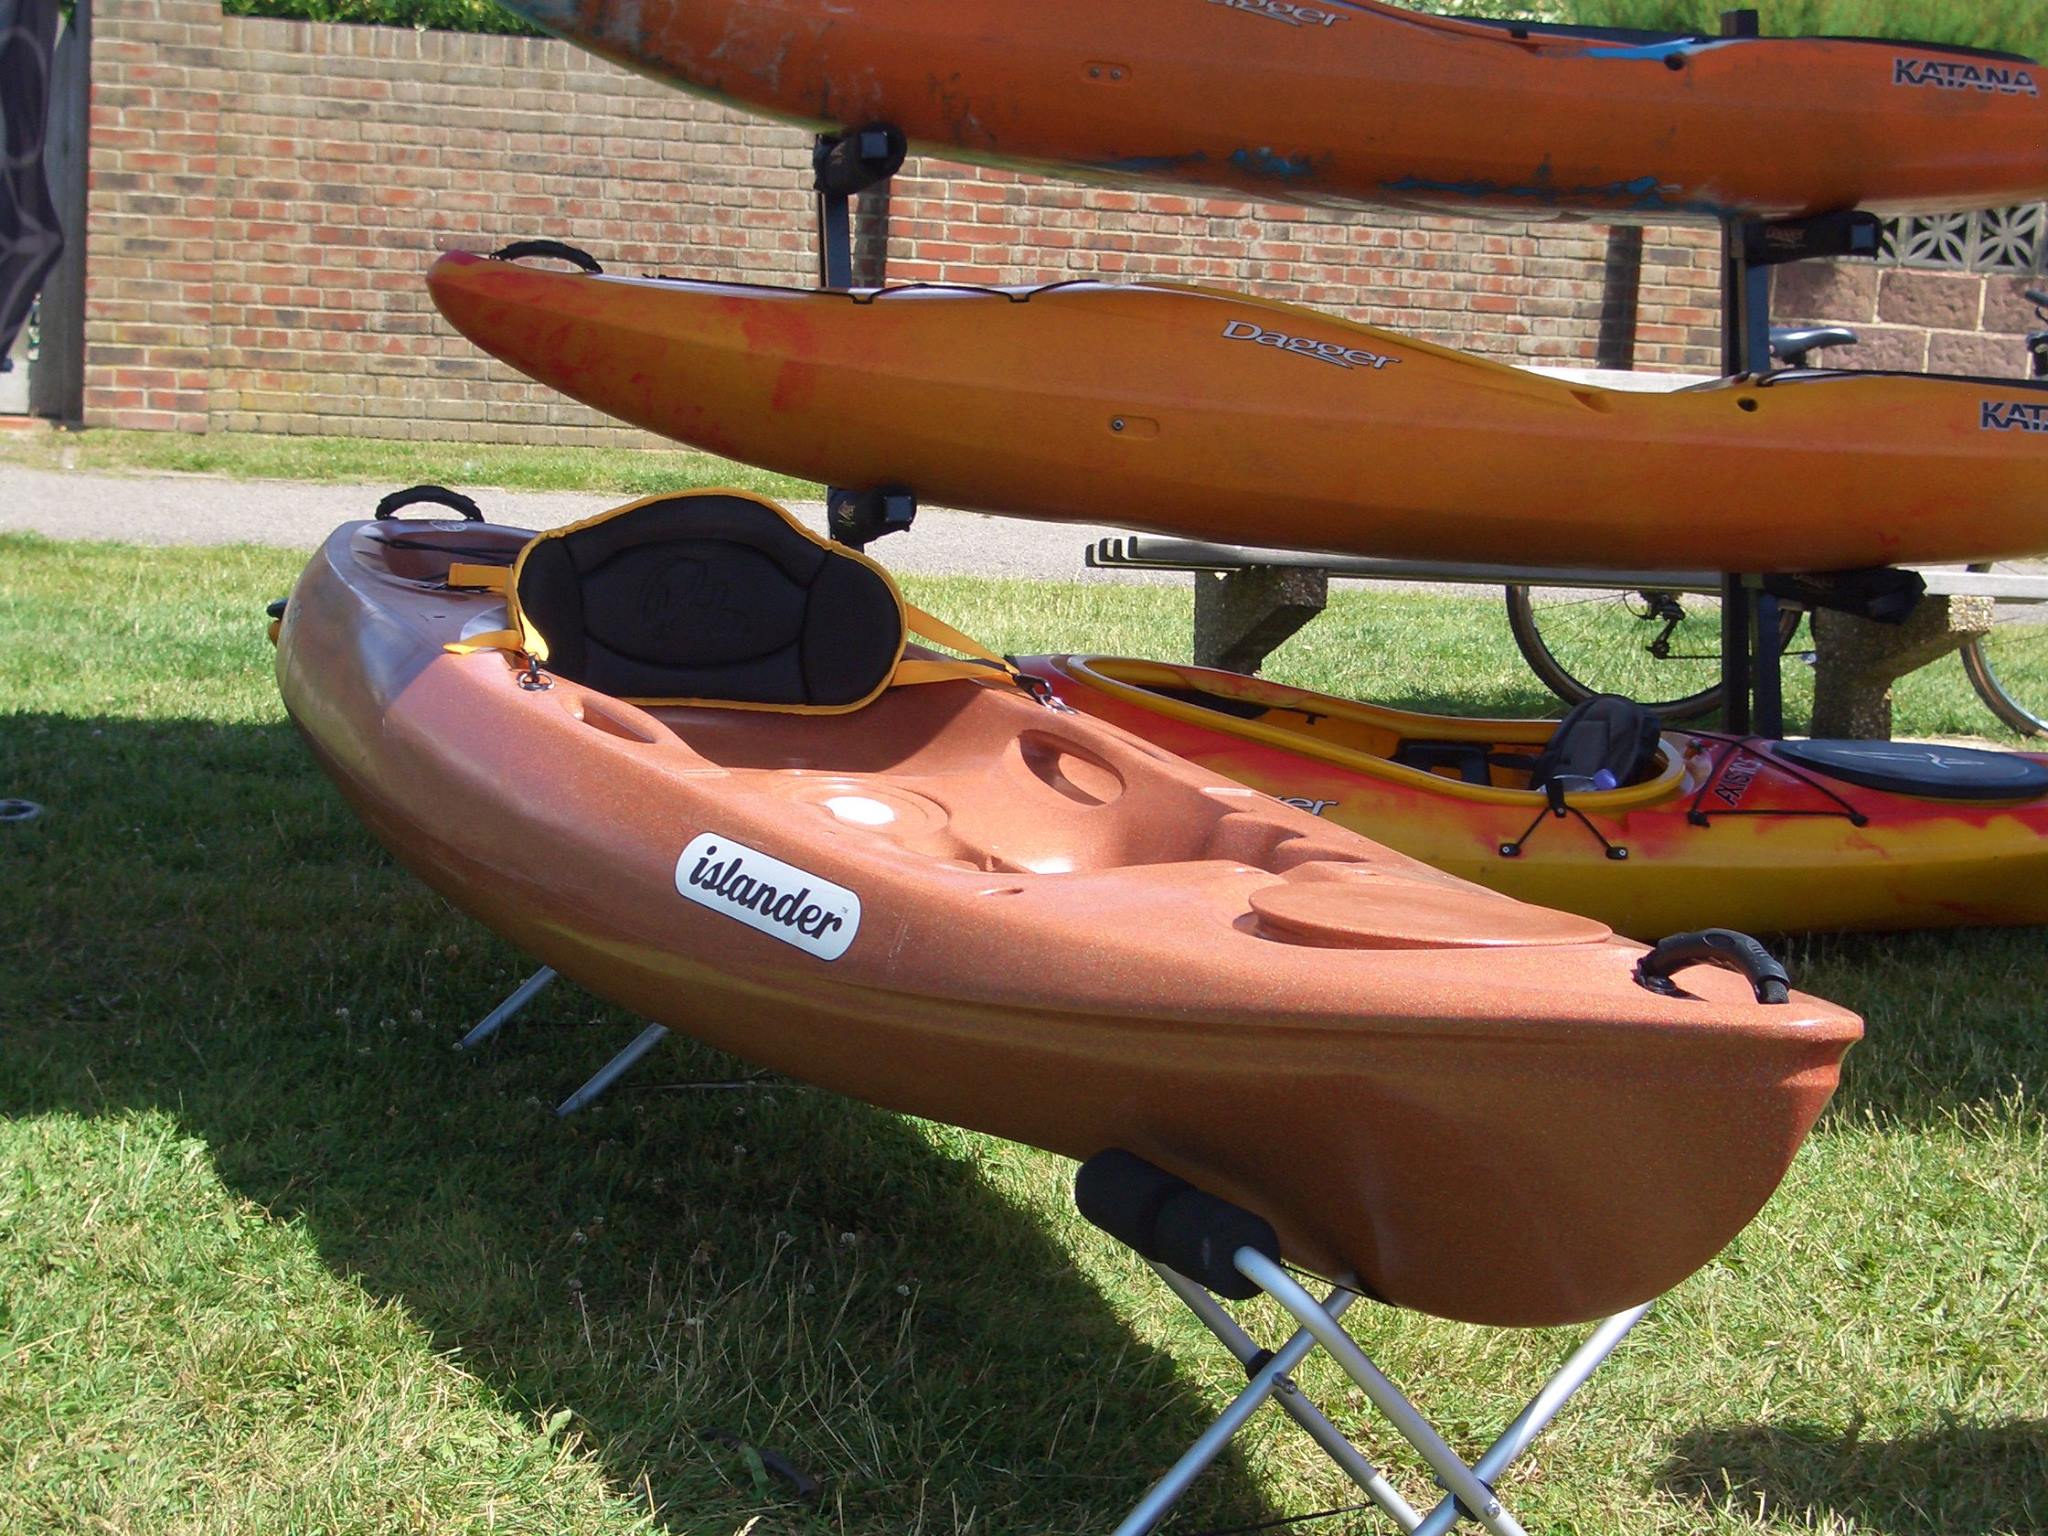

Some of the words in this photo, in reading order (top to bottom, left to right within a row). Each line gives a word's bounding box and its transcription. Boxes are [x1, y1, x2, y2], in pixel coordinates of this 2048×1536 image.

[1893, 56, 2039, 98] KATANA
[1222, 319, 1403, 370] Dagger
[1980, 400, 2048, 433] KAT
[1274, 796, 1340, 816] er
[688, 845, 844, 941] islander
